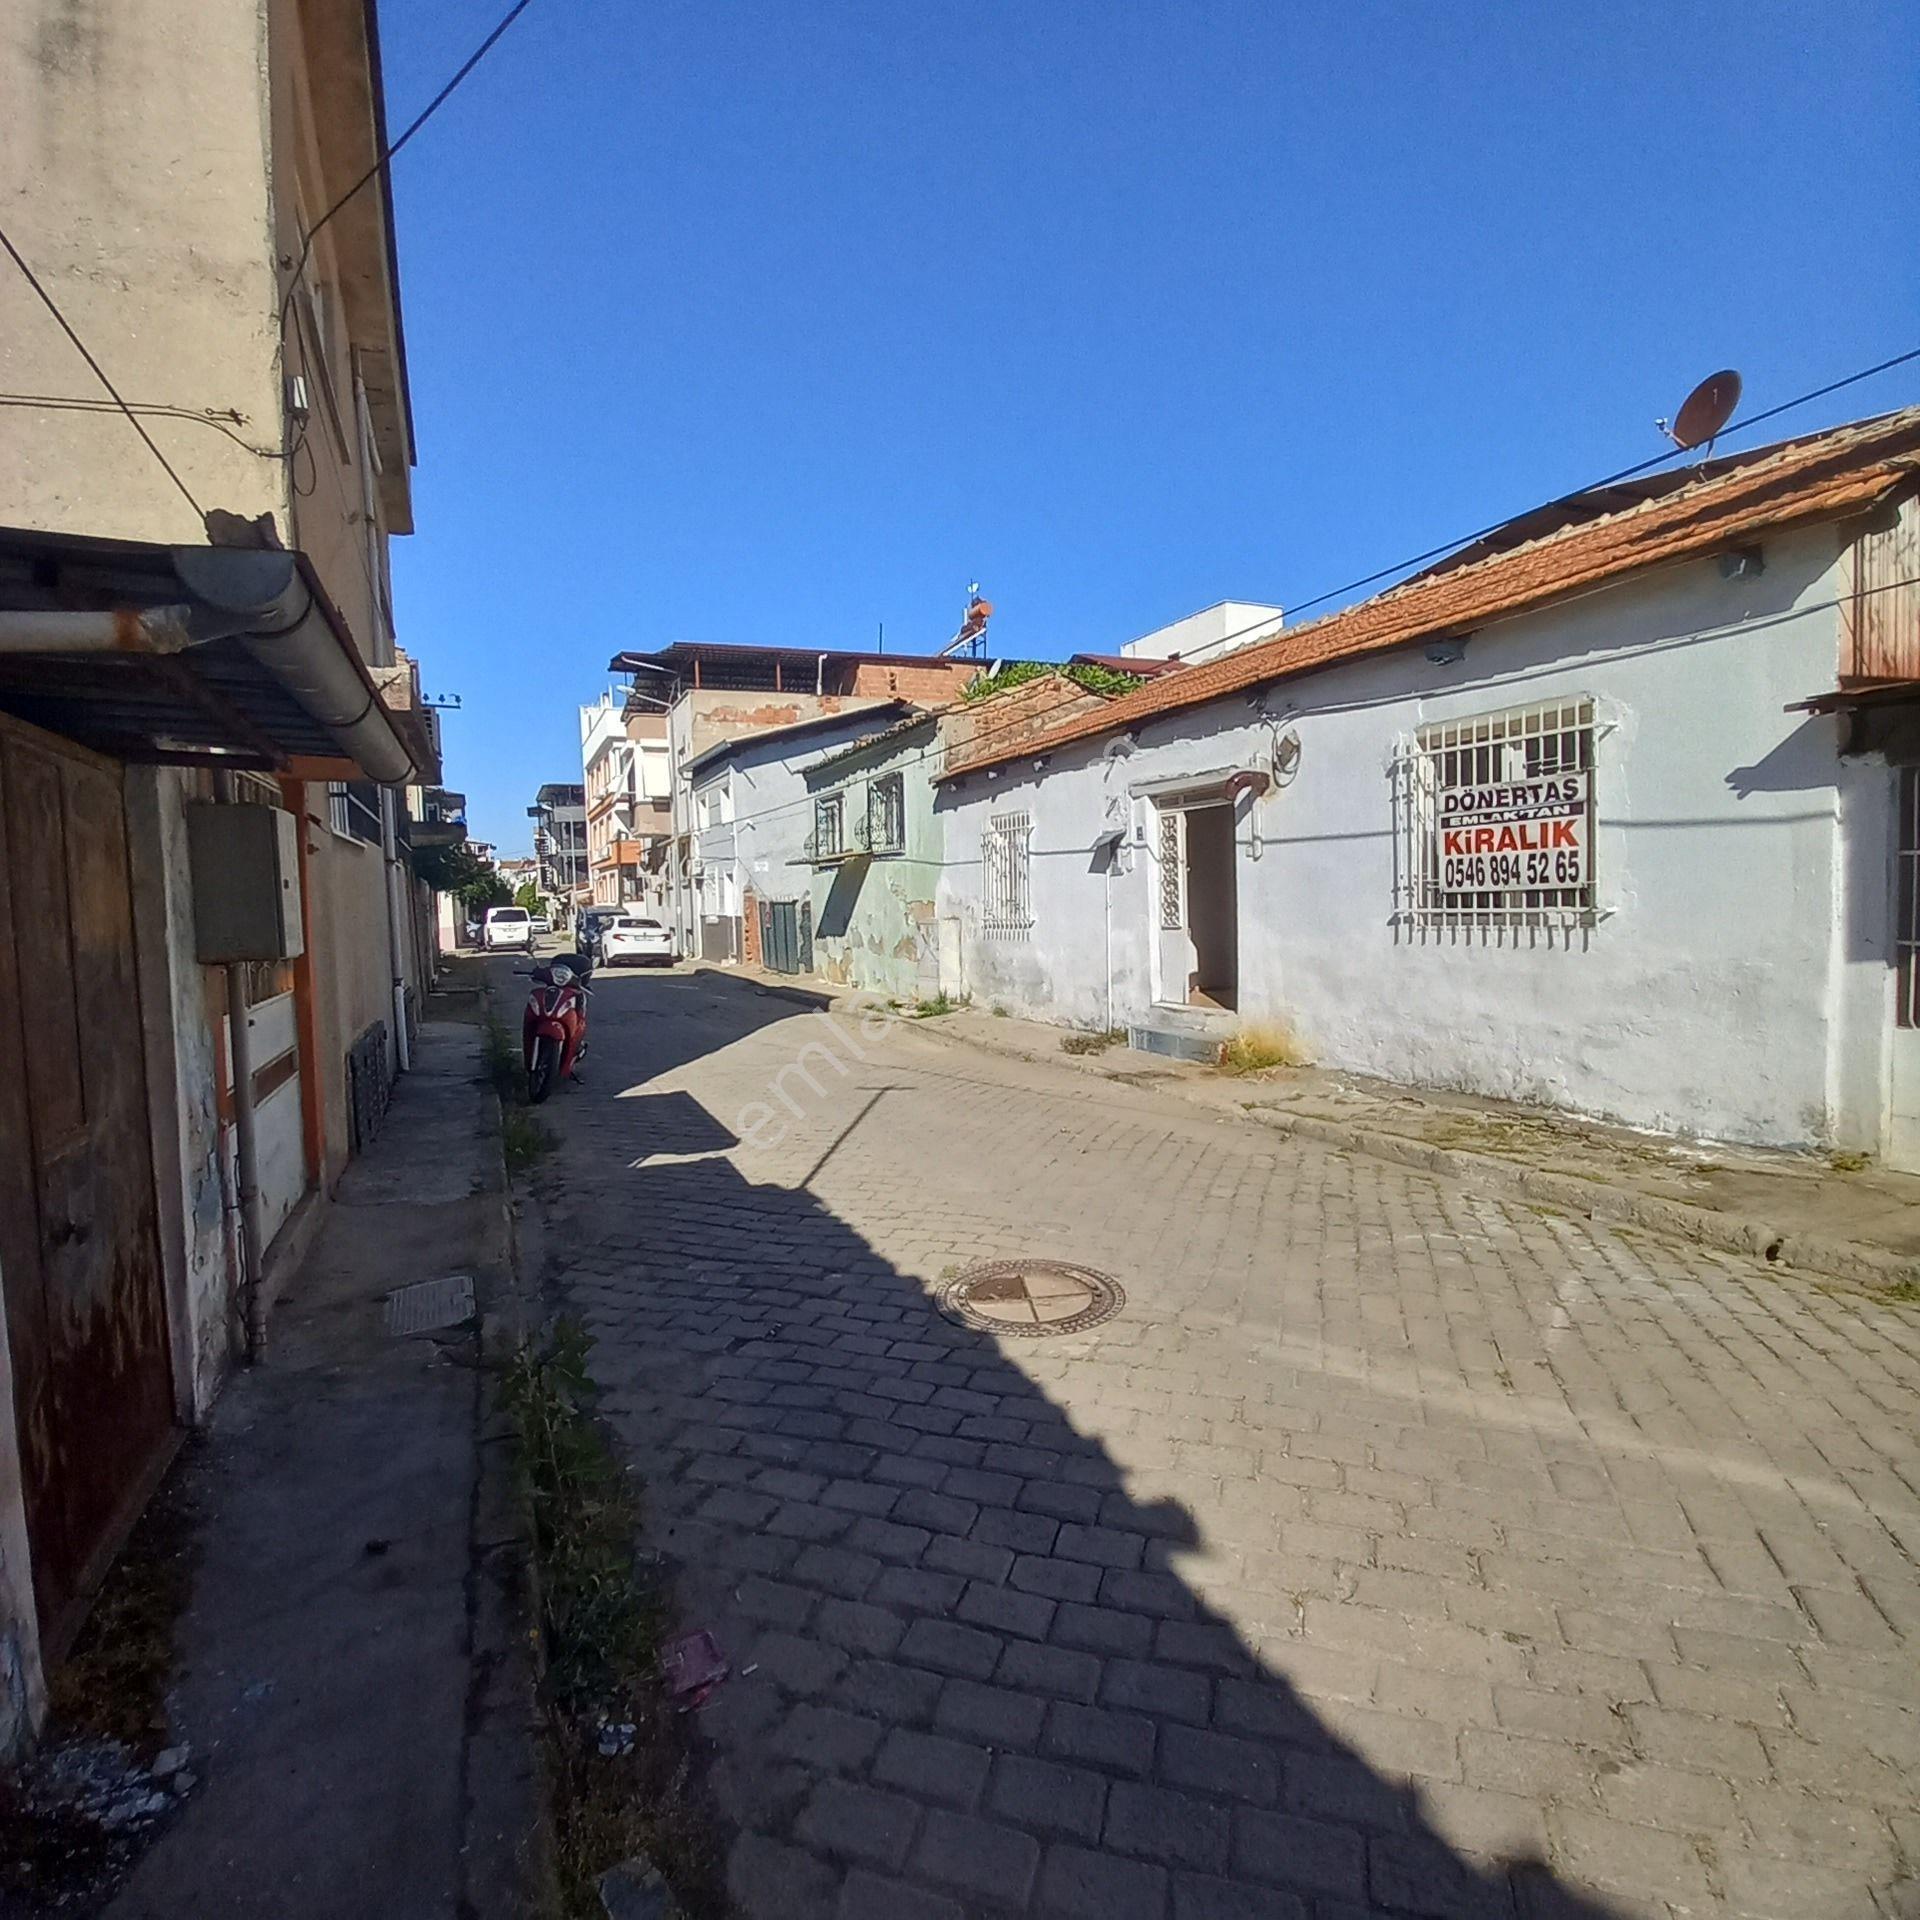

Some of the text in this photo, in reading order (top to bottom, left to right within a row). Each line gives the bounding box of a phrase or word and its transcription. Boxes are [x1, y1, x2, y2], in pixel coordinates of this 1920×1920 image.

[1449, 804, 1570, 826] EMLAK'TAN
[1445, 850, 1580, 889] 0546 894 52 65
